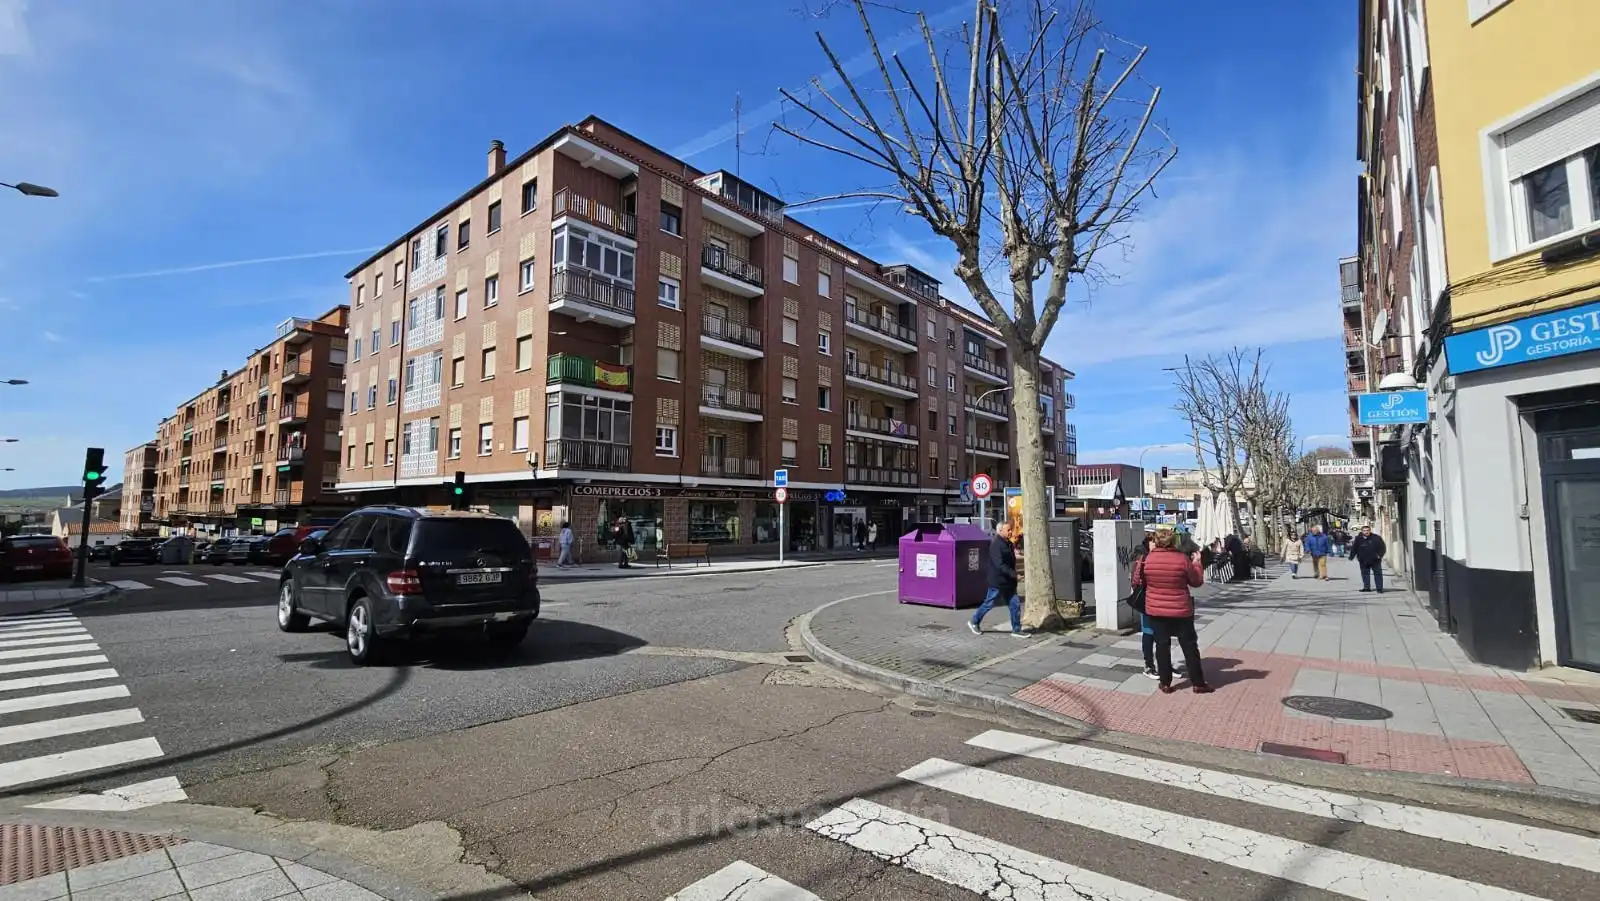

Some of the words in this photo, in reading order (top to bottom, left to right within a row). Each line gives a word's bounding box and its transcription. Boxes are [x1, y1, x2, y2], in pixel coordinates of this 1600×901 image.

[1526, 334, 1593, 356] GESTORÍA
[1367, 407, 1419, 418] GESTIÓN
[975, 481, 988, 490] 30
